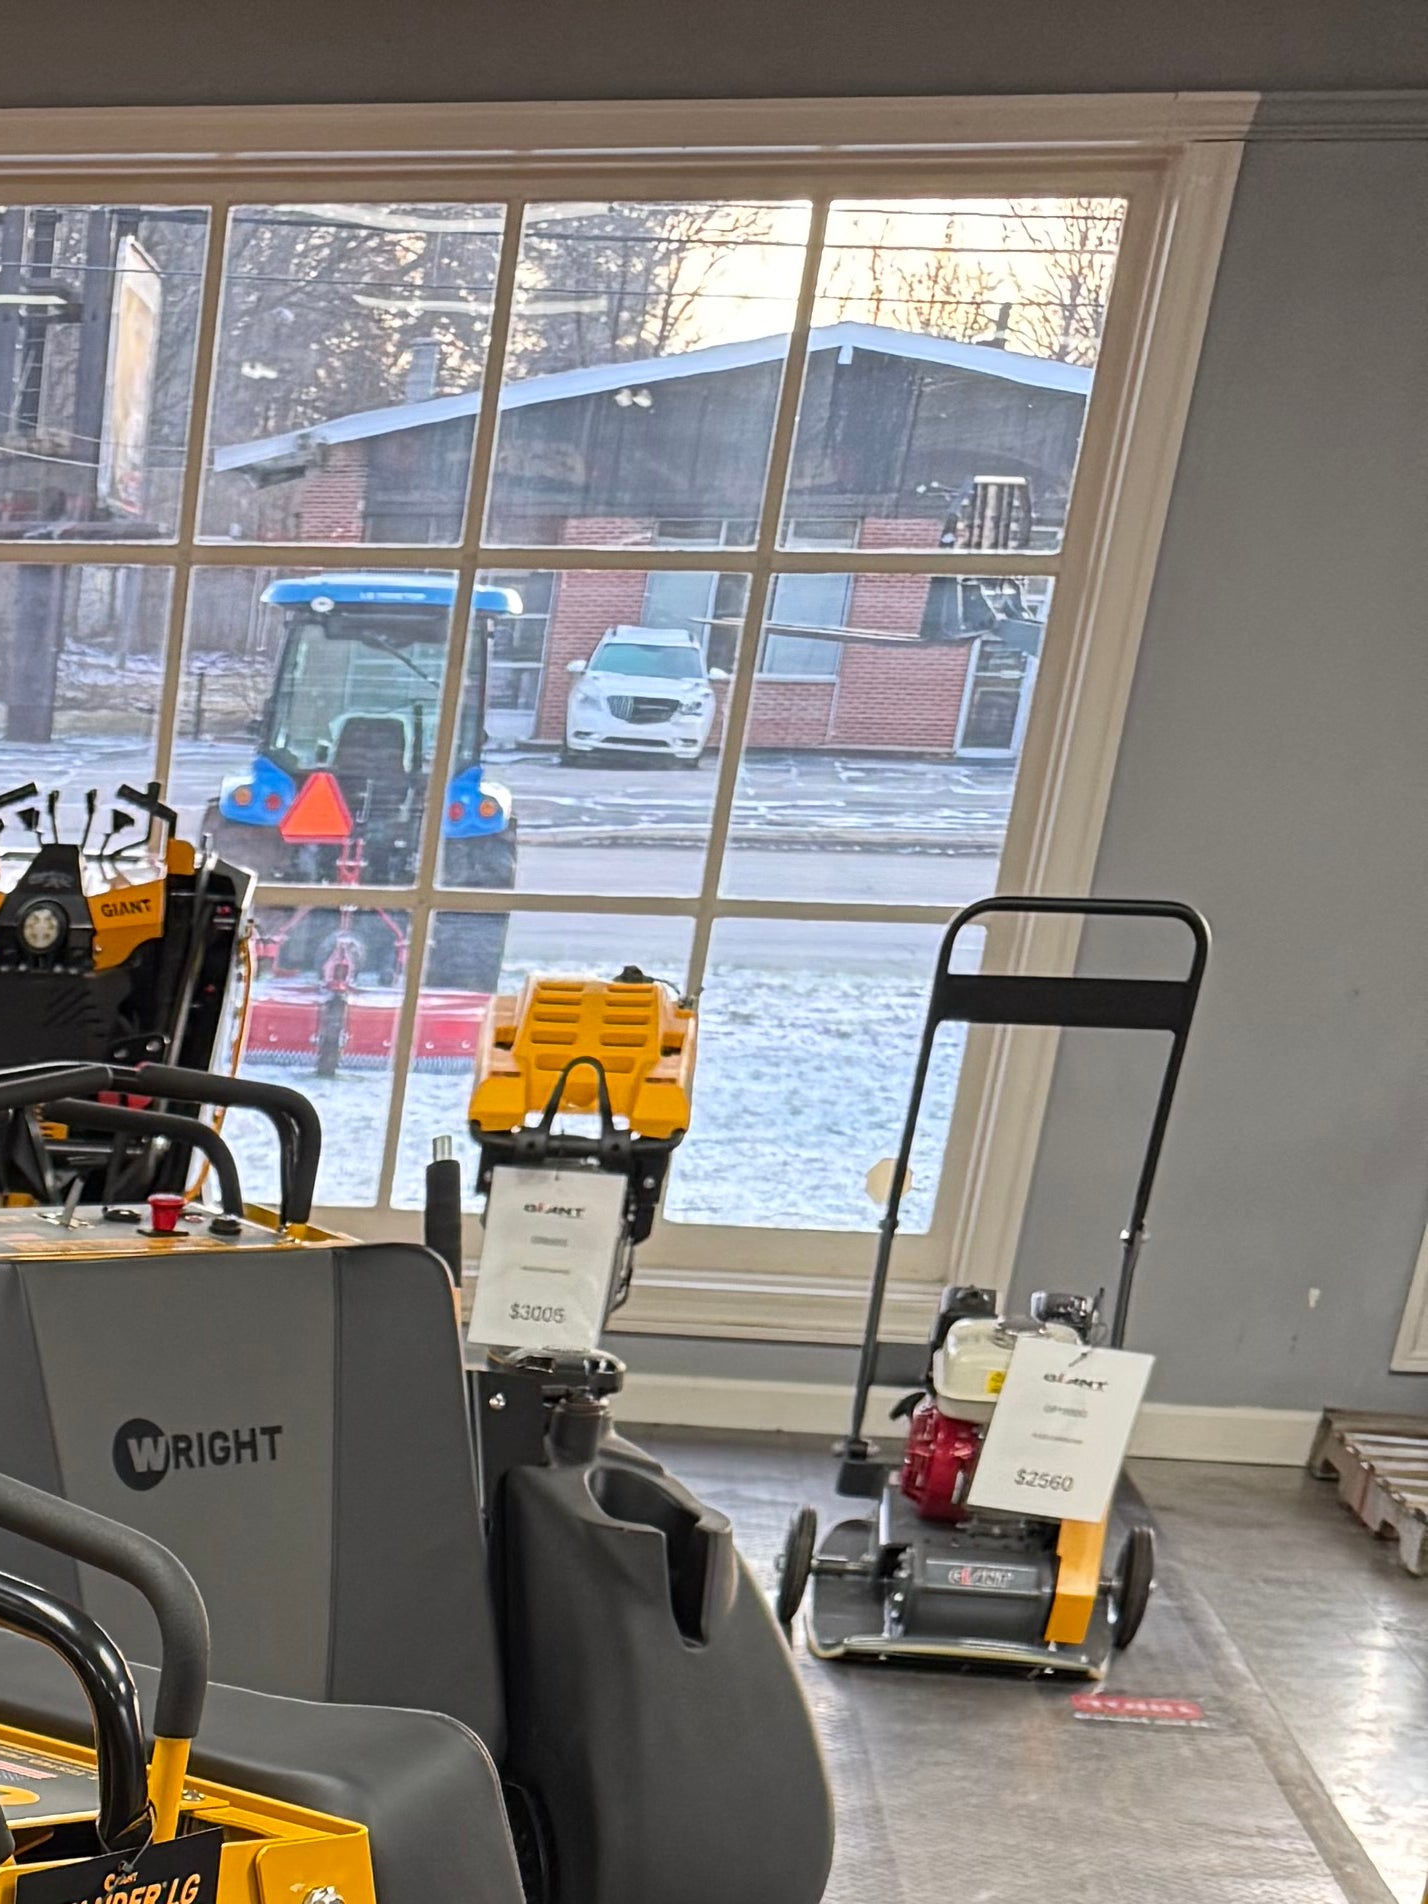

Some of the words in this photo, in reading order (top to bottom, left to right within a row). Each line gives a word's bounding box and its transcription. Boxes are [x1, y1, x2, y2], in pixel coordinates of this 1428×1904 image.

[101, 898, 152, 918] GIANT
[524, 1203, 585, 1219] GIANT
[118, 1420, 283, 1485] WRIGHT
[1014, 1468, 1074, 1492] $2560
